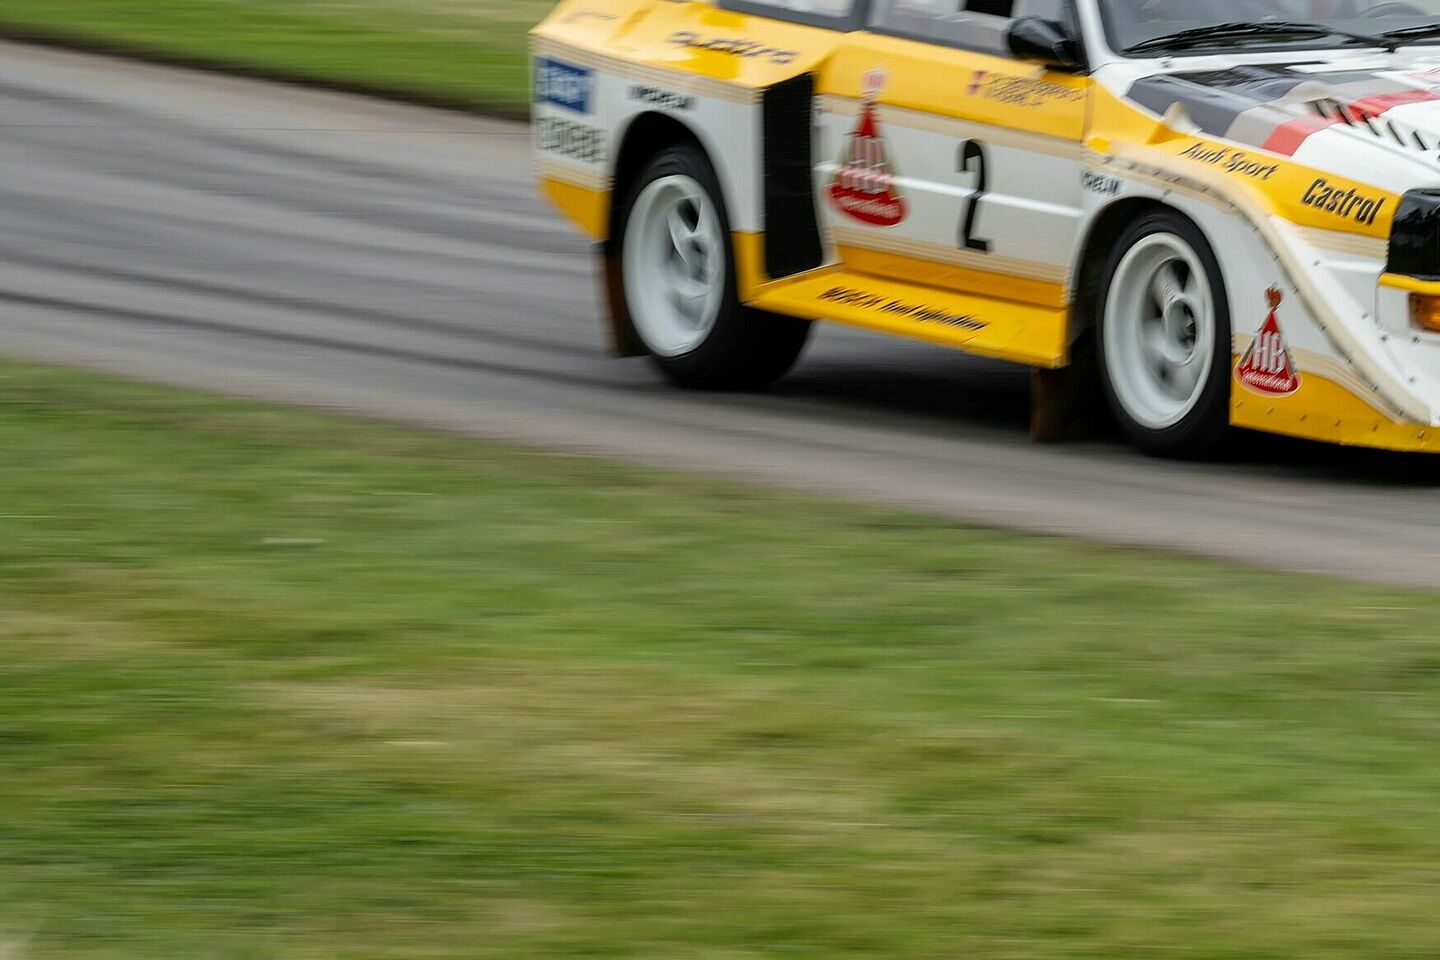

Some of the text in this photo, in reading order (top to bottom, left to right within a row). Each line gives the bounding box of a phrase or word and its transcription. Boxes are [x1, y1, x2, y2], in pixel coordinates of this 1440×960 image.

[667, 30, 799, 65] quattro
[1178, 142, 1280, 181] Audi Sport
[954, 138, 989, 253] 2
[1302, 177, 1386, 226] Castrol
[1250, 328, 1288, 374] HB
